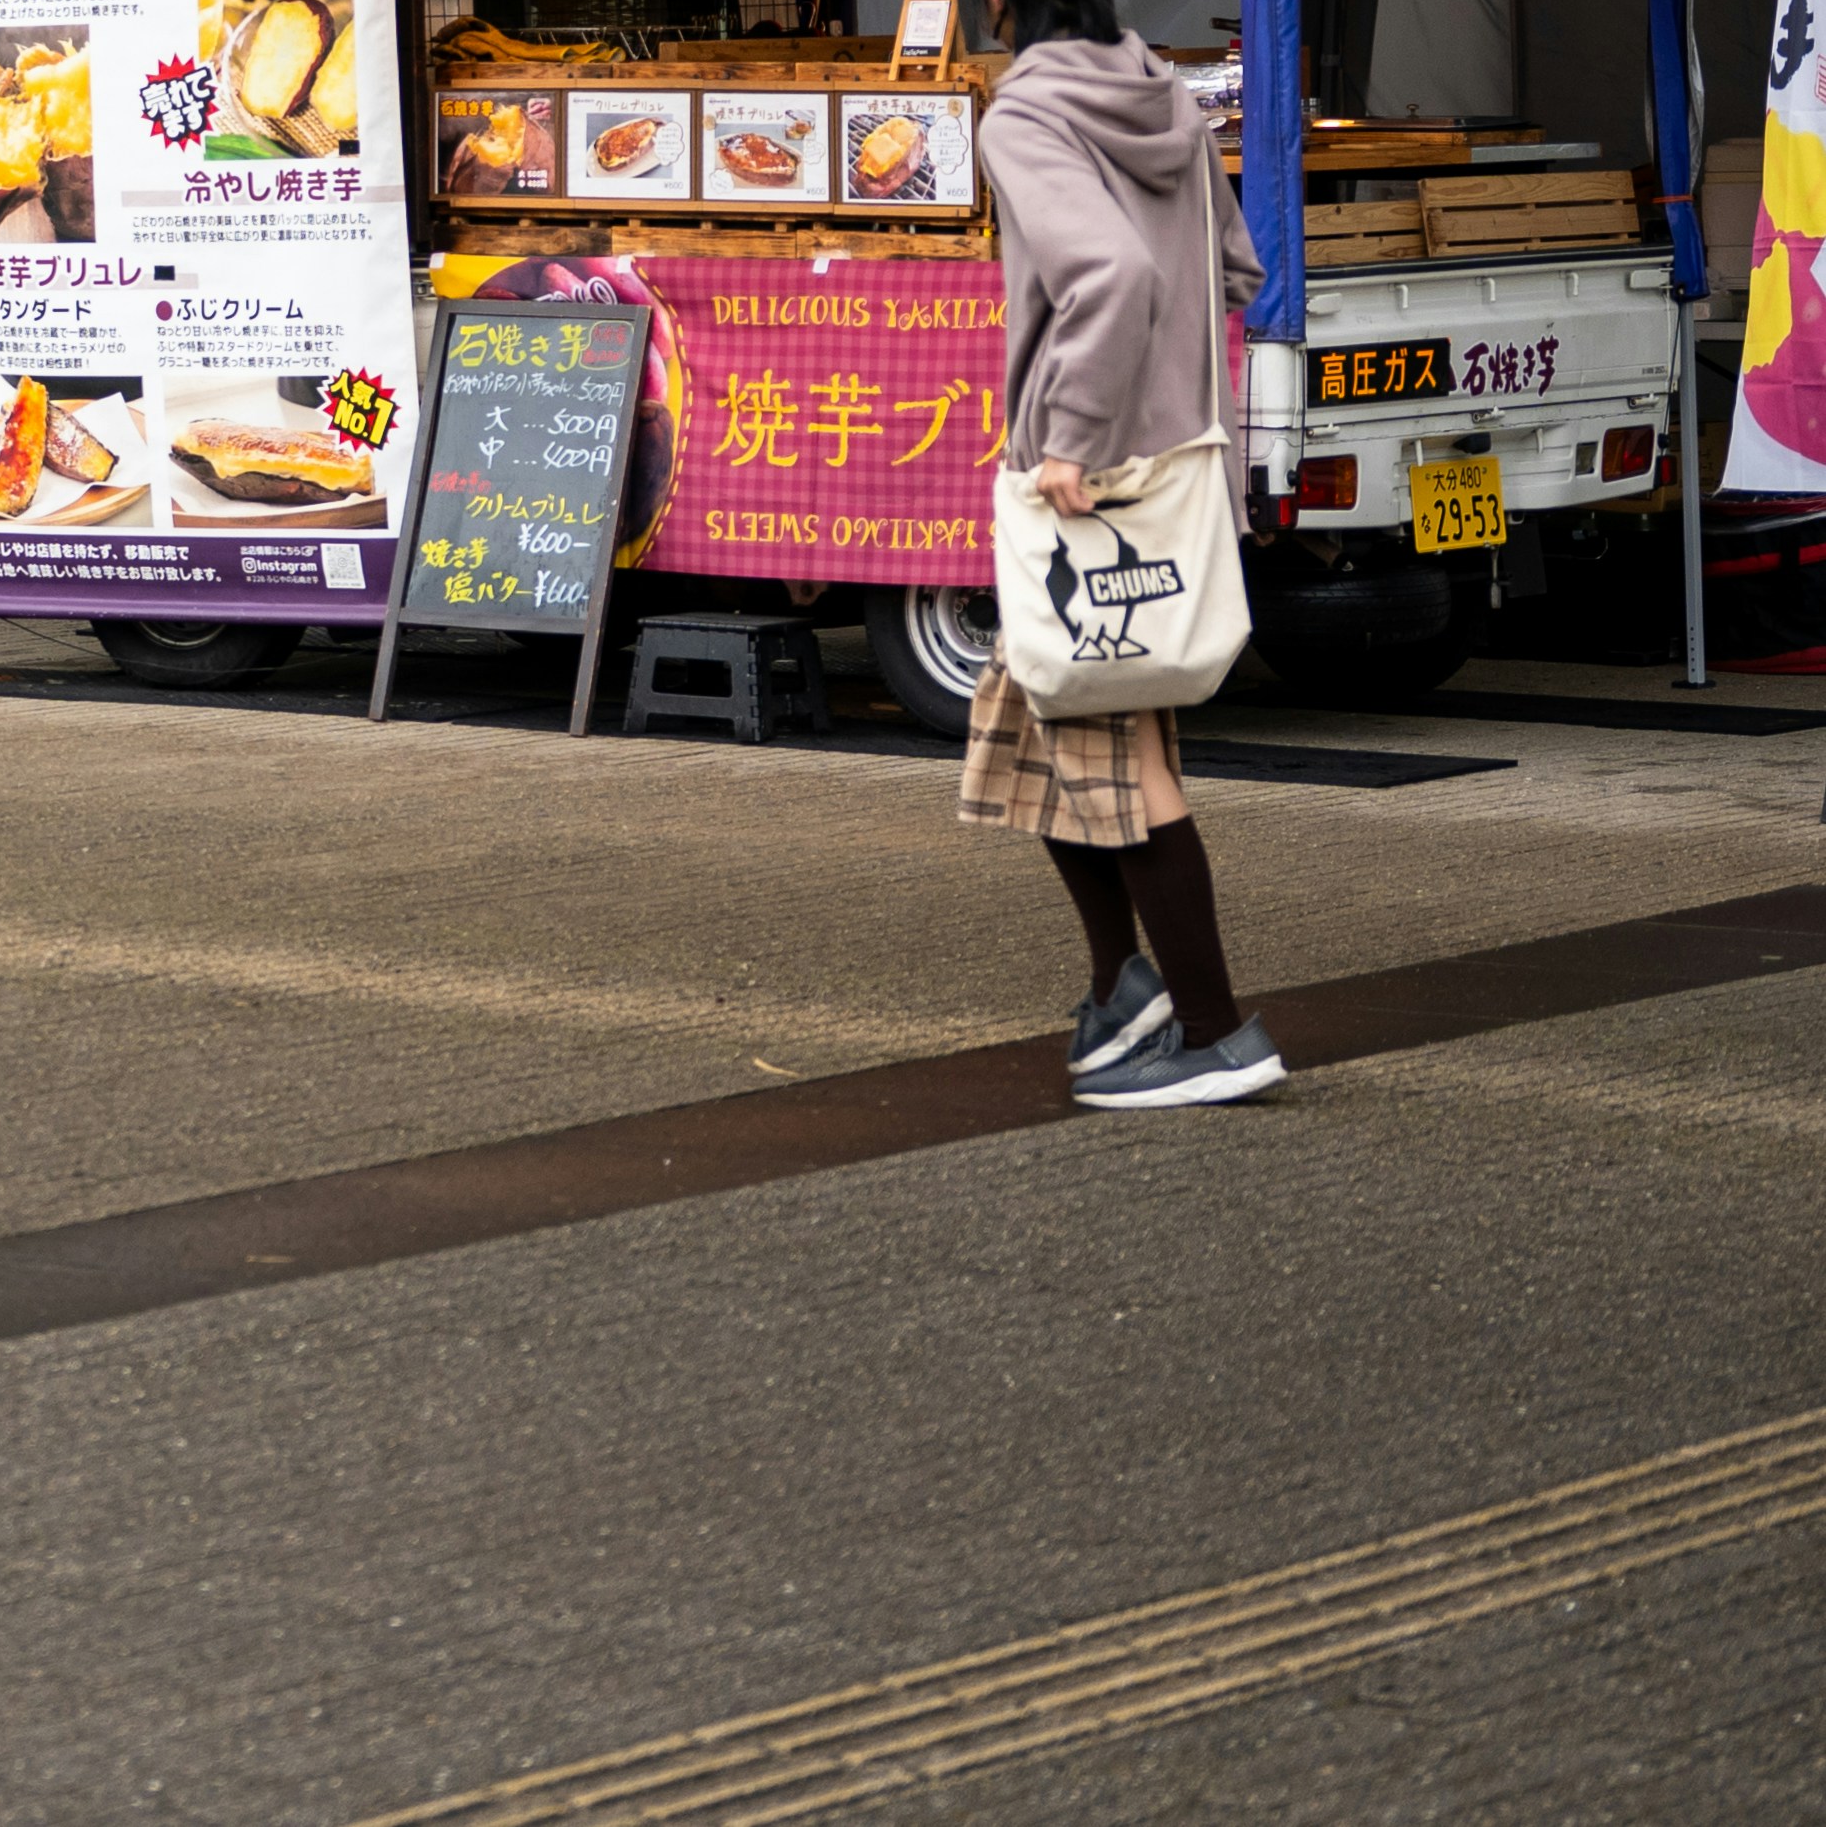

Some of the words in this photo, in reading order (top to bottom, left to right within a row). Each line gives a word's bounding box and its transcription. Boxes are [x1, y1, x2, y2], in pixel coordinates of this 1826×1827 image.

[140, 67, 213, 119] 売れて
[440, 99, 496, 117] 石焼き芋
[160, 100, 205, 140] ます
[184, 167, 363, 204] 冷やし焼き芋
[946, 187, 968, 197] ¥600
[176, 298, 304, 322] ふじクリーム
[713, 295, 870, 328] DELICIOUS
[883, 297, 1008, 332] YAKIIM
[449, 323, 585, 373] 石焼き芋
[1461, 334, 1560, 398] 石焼き芋
[1321, 347, 1438, 400] 高圧ガス
[712, 369, 1009, 468] 焼芋ブリ
[465, 493, 605, 525] クリームブリュレ
[1421, 511, 1431, 535] な
[257, 560, 317, 575] Instagram
[421, 536, 490, 569] 焼き芋
[1091, 565, 1179, 602] CHUMS
